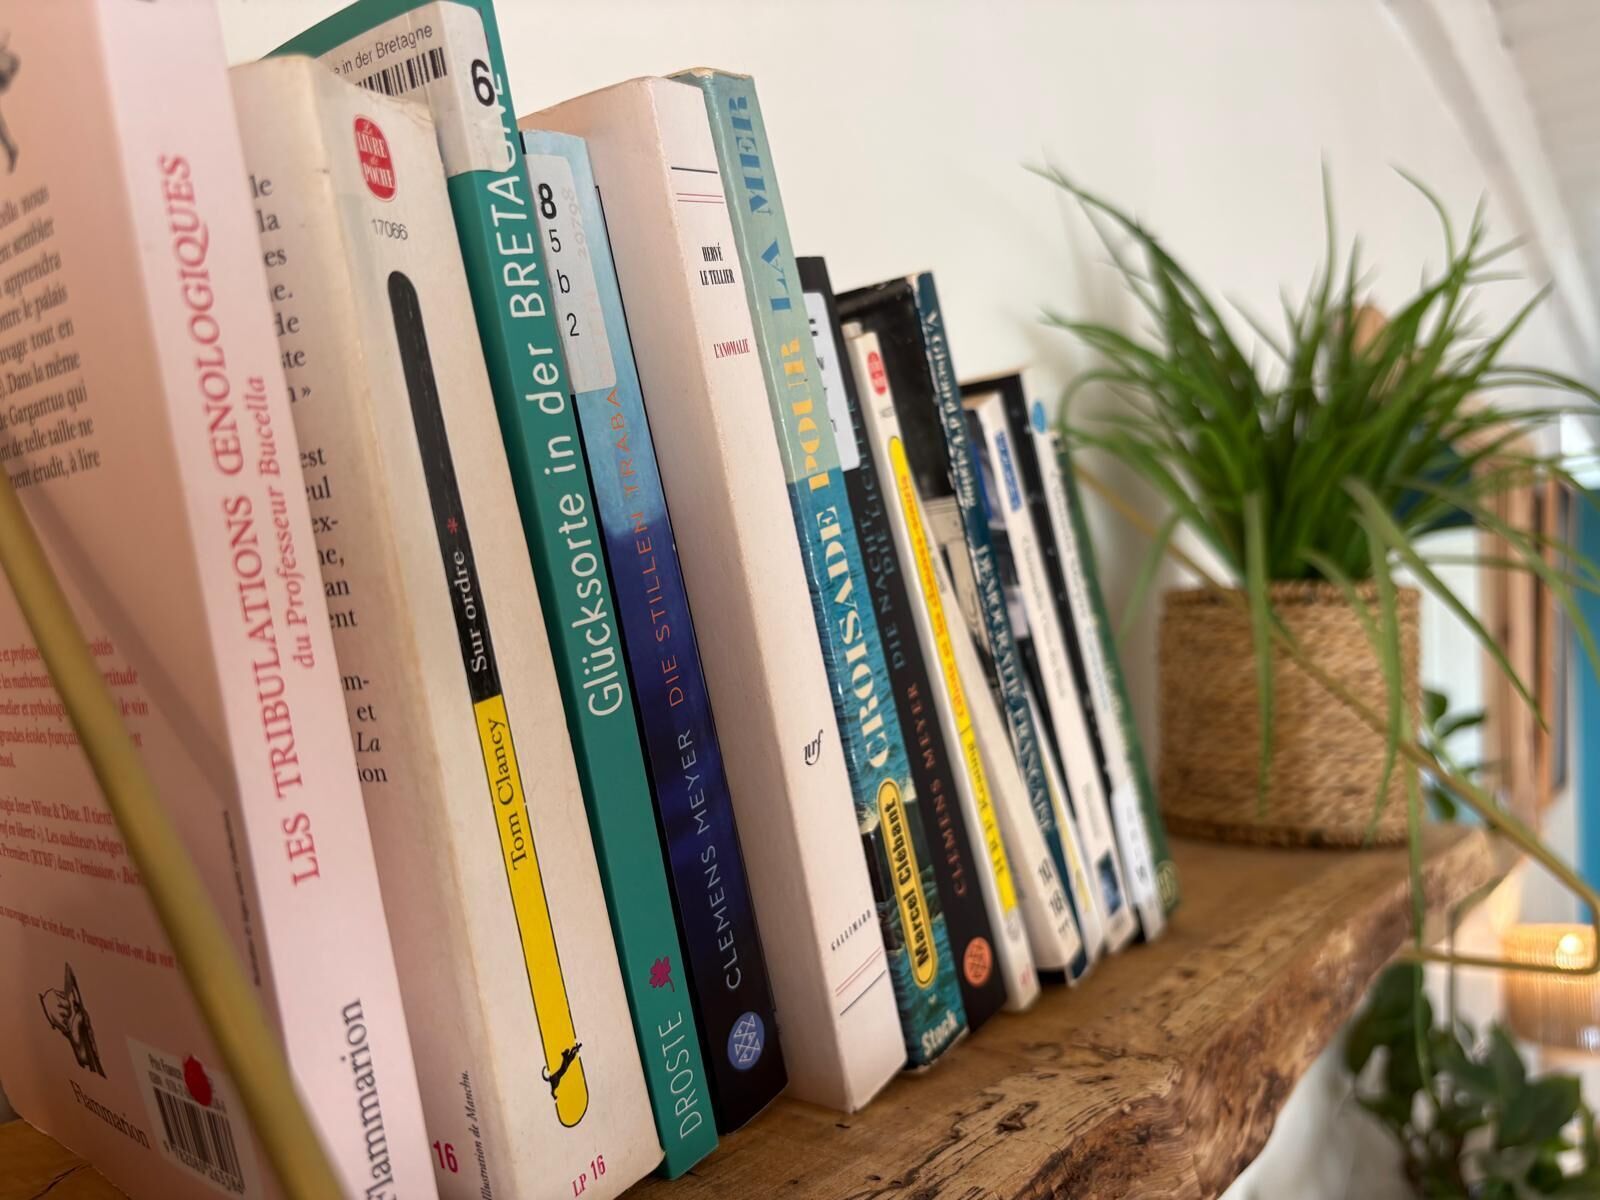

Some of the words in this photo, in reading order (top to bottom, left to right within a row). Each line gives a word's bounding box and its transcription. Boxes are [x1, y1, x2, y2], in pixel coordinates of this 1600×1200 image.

[343, 60, 352, 74] in
[355, 49, 377, 70] der
[376, 24, 433, 60] Bretagne
[471, 58, 496, 107] 6
[357, 133, 388, 158] LIVRE
[729, 95, 774, 216] MER
[362, 162, 394, 188] POCHE
[255, 209, 281, 233] la
[538, 182, 558, 220] 8
[371, 218, 409, 241] 17066
[548, 228, 562, 253] 5
[701, 241, 723, 263] HERVÉ
[4, 251, 62, 299] apprendra
[264, 249, 287, 268] es
[556, 269, 571, 294] b
[699, 270, 710, 286] LE
[709, 268, 736, 285] TELLIER
[761, 239, 792, 312] LA
[35, 283, 68, 322] palais
[159, 153, 244, 476] ŒNOLOGIQUES
[566, 312, 580, 337] 2
[30, 325, 56, 352] tout
[58, 319, 75, 341] en
[713, 337, 751, 359] L'ANOMALIE
[6, 371, 34, 396] Dans
[33, 361, 45, 383] la
[45, 350, 81, 381] même
[525, 342, 565, 415] der
[8, 392, 65, 427] Gargantua
[67, 377, 88, 413] qui
[243, 375, 281, 477] Bucella
[780, 337, 831, 494] POUR
[12, 436, 25, 458] de
[24, 427, 48, 454] telle
[47, 417, 77, 447] taille
[78, 417, 94, 439] ne
[77, 445, 102, 473] lire
[544, 434, 577, 476] in
[605, 386, 640, 498] TRABA
[268, 487, 308, 627] Professeur
[875, 528, 896, 575] DIE
[325, 579, 350, 598] an
[453, 550, 477, 621] ordre
[630, 510, 671, 643] STILLEN
[558, 492, 624, 717] Glücksorte
[223, 495, 303, 800] TRIBULATIONS
[291, 634, 316, 670] du
[470, 625, 488, 674] Sur
[816, 505, 890, 769] CROISADE
[885, 622, 905, 670] DIE
[661, 653, 685, 708] DIE
[357, 704, 376, 721] et
[907, 681, 937, 771] MEYER
[357, 731, 382, 753] La
[487, 717, 515, 807] Clancy
[803, 728, 824, 766] nrf
[677, 727, 708, 836] MEYER
[282, 811, 321, 887] LES
[508, 812, 528, 871] Tom
[884, 797, 912, 886] Clébant
[929, 778, 968, 897] CLEMENS
[700, 843, 742, 992] CLEMENS
[903, 887, 930, 969] Marcel
[920, 1010, 959, 1057] Stock
[658, 1010, 702, 1139] DROSTE
[69, 1078, 151, 1150] Flammarion
[432, 1139, 459, 1174] 16
[571, 1173, 587, 1198] LP
[589, 1154, 607, 1181] 16
